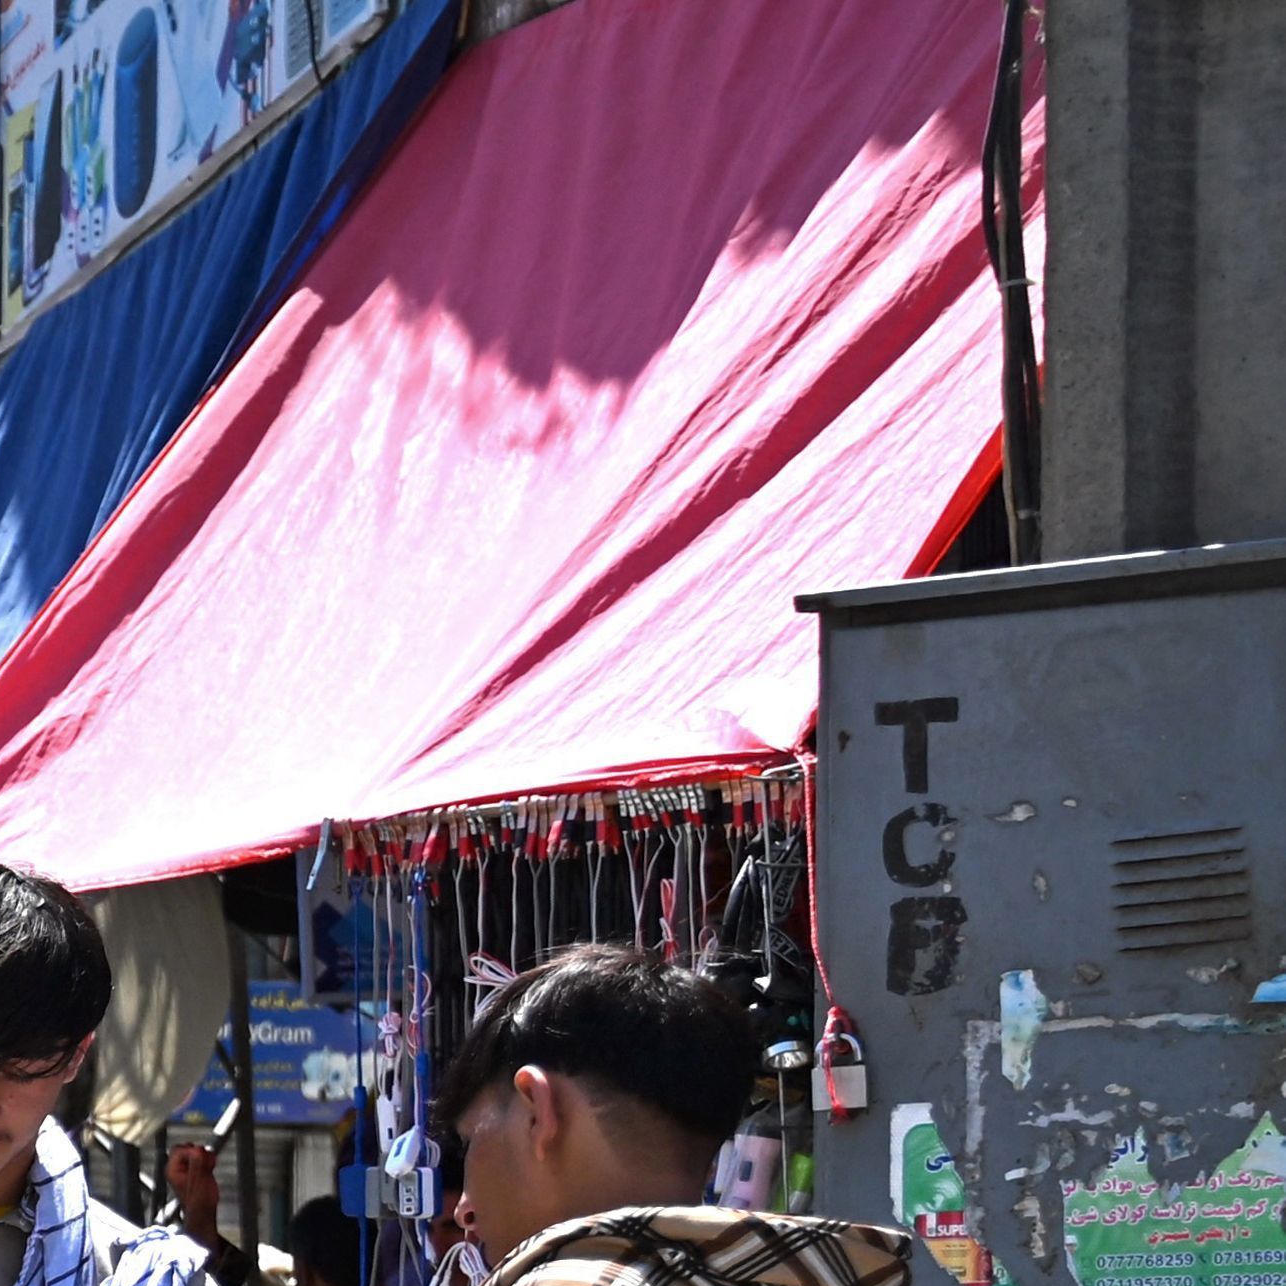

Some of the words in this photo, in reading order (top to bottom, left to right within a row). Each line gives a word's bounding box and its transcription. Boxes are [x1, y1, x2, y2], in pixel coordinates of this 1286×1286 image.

[1102, 1177, 1134, 1193] مواد
[936, 1223, 969, 1237] SUPE
[1096, 1252, 1194, 1269] 0777768259
[1213, 1250, 1286, 1266] 0781669
